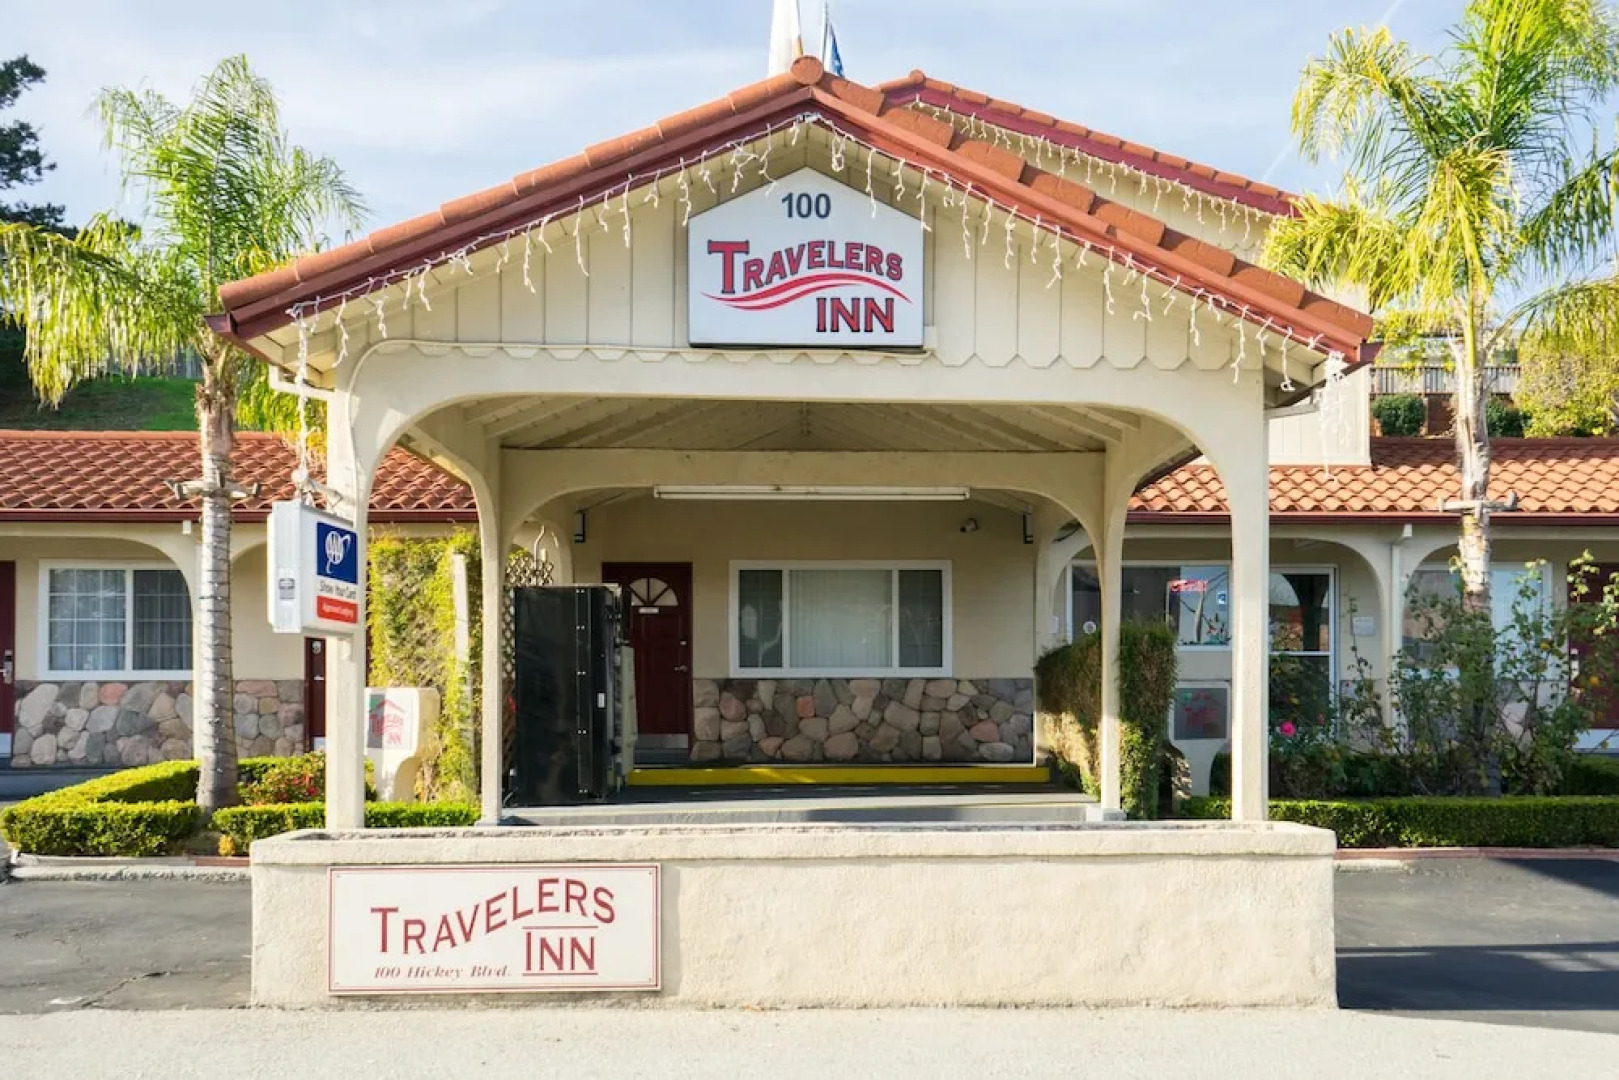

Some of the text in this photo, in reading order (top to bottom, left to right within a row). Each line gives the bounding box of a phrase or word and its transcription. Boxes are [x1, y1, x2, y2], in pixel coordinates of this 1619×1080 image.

[781, 192, 832, 219] 100
[707, 239, 903, 294] TRAVELERS
[816, 297, 894, 333] INN
[370, 877, 616, 955] TRAVELERS
[525, 931, 595, 971] INN
[374, 964, 512, 981] 100 Hickey Blvd.
